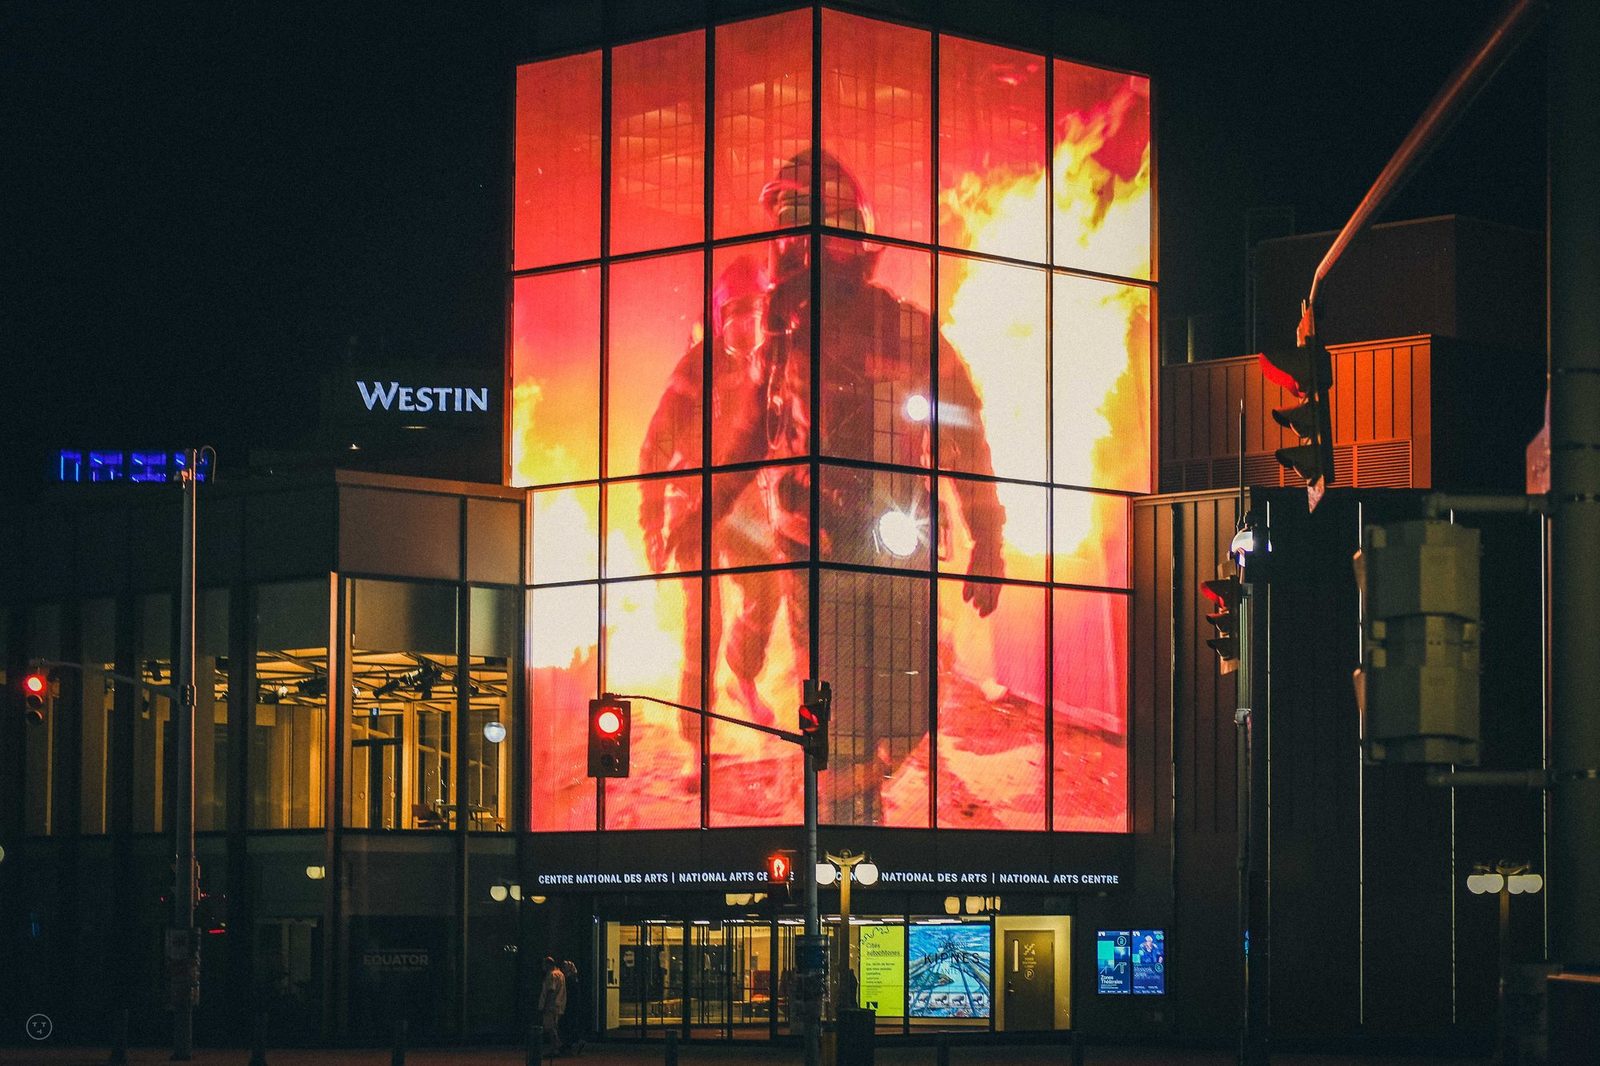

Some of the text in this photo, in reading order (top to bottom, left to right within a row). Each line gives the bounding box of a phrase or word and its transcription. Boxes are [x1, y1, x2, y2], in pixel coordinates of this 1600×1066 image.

[356, 380, 489, 412] WESTIN
[538, 874, 574, 884] CENTRE
[576, 873, 622, 884] NATIONAL
[624, 873, 642, 884] DES
[644, 873, 668, 883] ARTS
[679, 872, 727, 883] NATIONAL
[729, 871, 754, 882] ARTS
[881, 872, 934, 883] NATIONAL
[937, 873, 958, 883] DES
[960, 873, 988, 884] ARTS
[999, 873, 1050, 884] NATIONAL
[1053, 873, 1079, 884] ARTS
[1081, 874, 1119, 885] CENTRE
[924, 952, 980, 964] KIPNES
